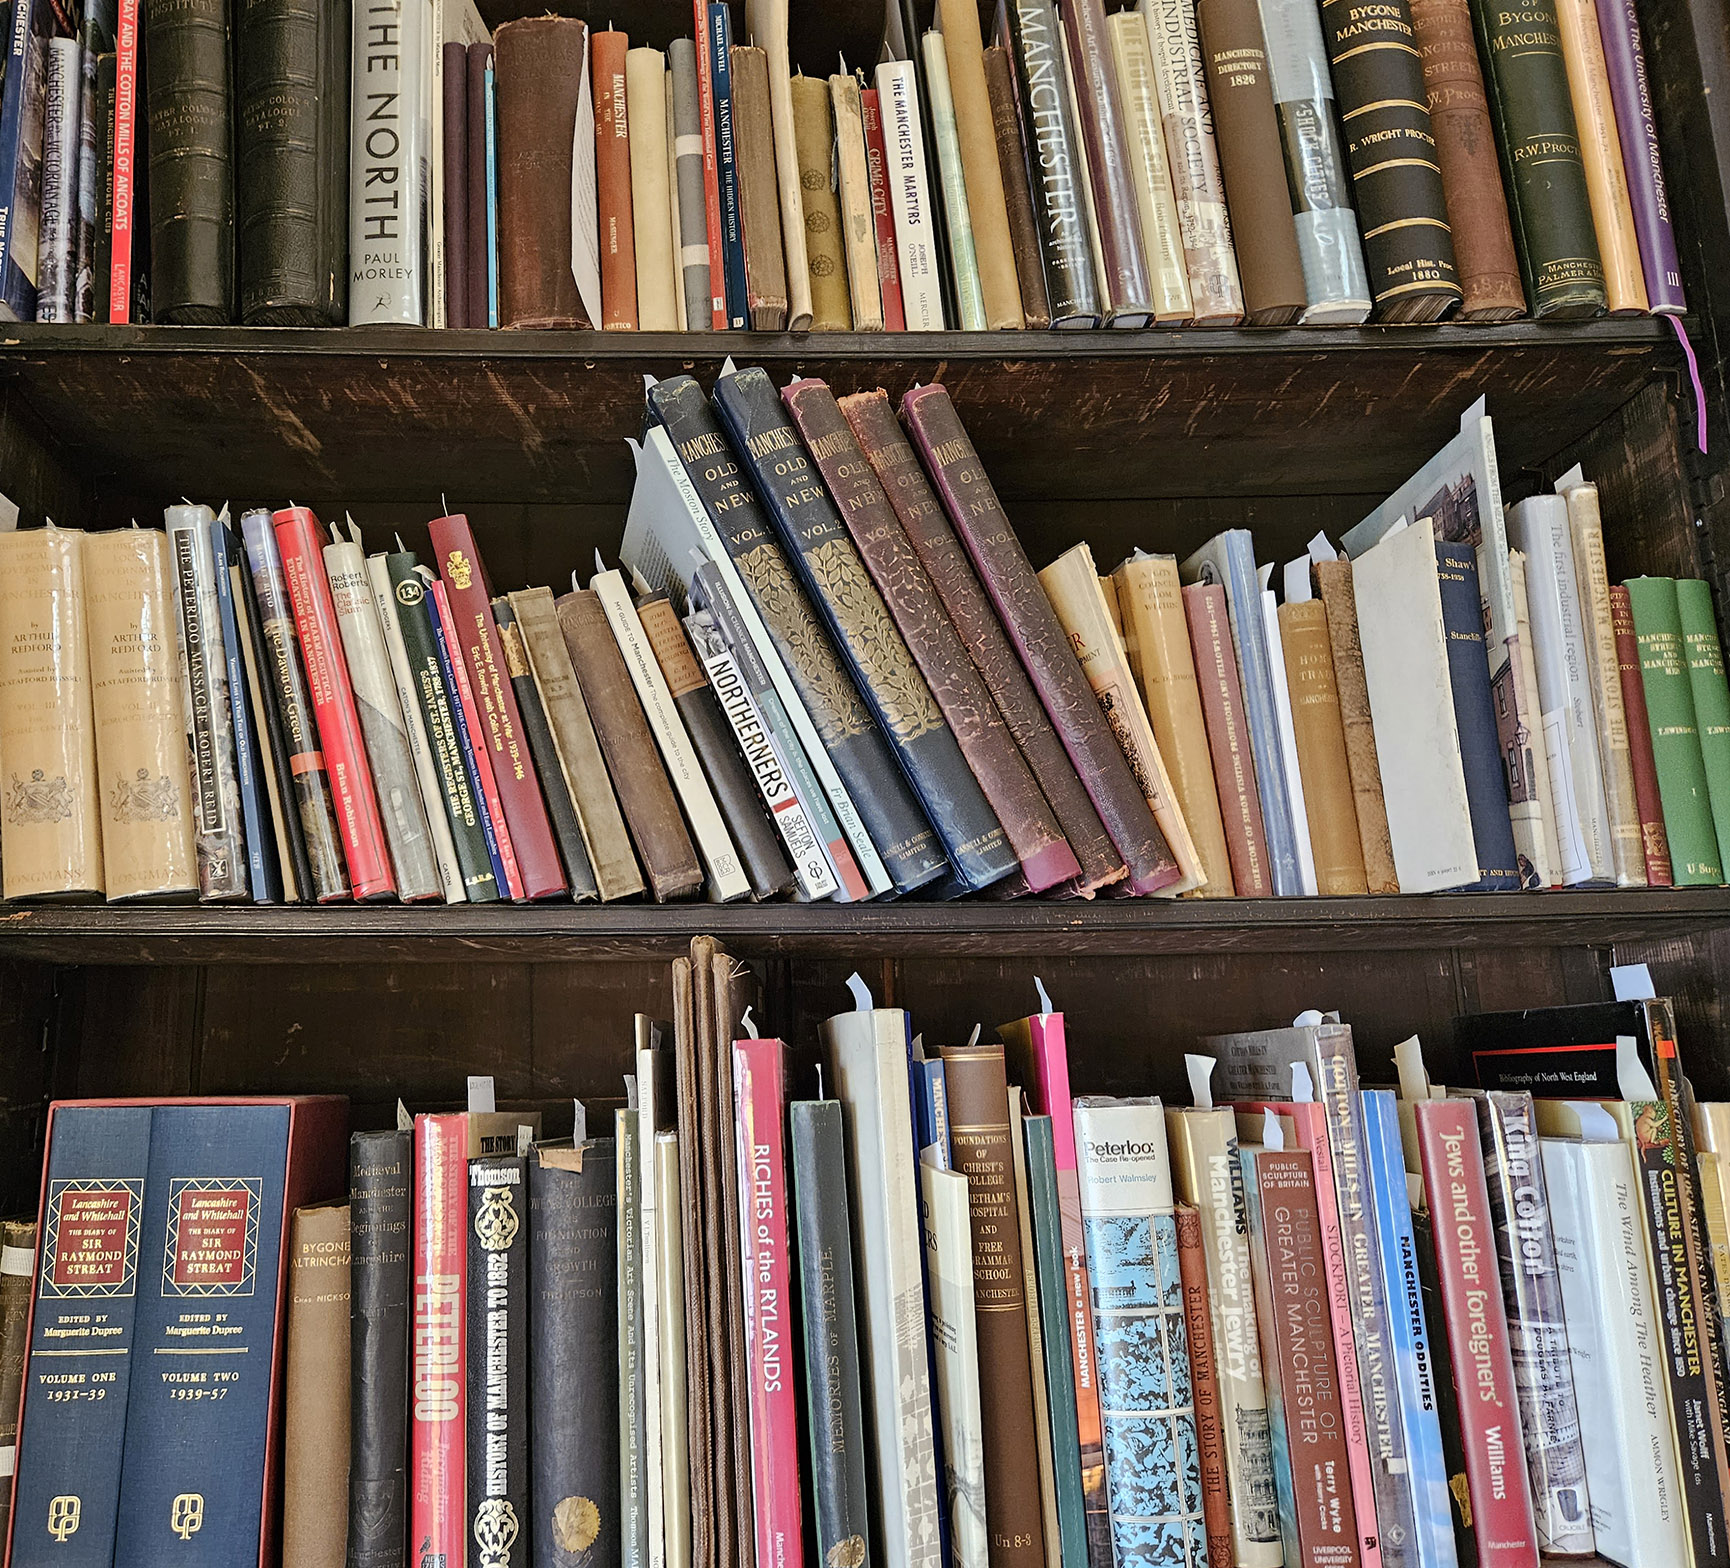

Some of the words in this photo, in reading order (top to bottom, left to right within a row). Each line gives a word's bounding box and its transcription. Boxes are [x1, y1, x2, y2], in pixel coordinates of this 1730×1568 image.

[1349, 4, 1402, 21] BYGONE
[120, 22, 136, 48] AND
[366, 0, 400, 73] THE
[1336, 18, 1414, 42] MANCHESTER
[1628, 22, 1641, 52] the
[119, 50, 135, 74] THE
[1213, 48, 1264, 63] MANCHESTER
[1216, 61, 1262, 75] DIRECTORY
[892, 77, 903, 97] THE
[1230, 74, 1256, 88] 1826
[1634, 54, 1653, 121] University
[107, 88, 115, 104] THE
[118, 75, 134, 120] COTTON
[612, 73, 629, 139] MANCHESTER
[1161, 0, 1190, 110] INDUSTRIAL
[1180, 117, 1208, 194] SOCIETY
[719, 98, 732, 164] MANCHESTER
[1017, 6, 1078, 234] MANCHESTER
[1645, 122, 1658, 143] of
[106, 110, 114, 165] MANCHESTER
[117, 121, 131, 155] MILLS
[893, 98, 914, 170] MANCHESTER
[1349, 142, 1360, 154] R.
[1360, 128, 1402, 147] WRIGHT
[116, 156, 130, 172] OF
[364, 92, 400, 240] NORTH
[105, 171, 113, 206] REFORM
[1648, 141, 1670, 224] Manchester
[114, 174, 129, 230] ANCOATS
[726, 187, 735, 213] HIDDEN
[903, 174, 921, 226] MARTYRS
[104, 210, 112, 234] CLUB
[728, 214, 737, 243] HISTORY
[364, 253, 400, 265] PAUL
[918, 243, 929, 275] JOSEPH
[1386, 260, 1414, 276] Local
[1415, 258, 1437, 270] Hist.
[353, 267, 413, 283] MORLEY
[1412, 270, 1441, 282] 1880
[919, 291, 930, 328] MERCIER
[704, 461, 740, 483] OLD
[774, 455, 808, 478] OLD
[790, 474, 810, 486] AND
[719, 479, 739, 491] AND
[784, 485, 826, 510] NEW
[667, 456, 680, 475] The
[674, 474, 698, 515] Moston
[694, 513, 714, 543] Story
[713, 492, 756, 516] NEW
[1551, 524, 1562, 544] The
[180, 533, 192, 566] THE
[1552, 549, 1565, 577] first
[330, 571, 363, 583] Robert
[1444, 556, 1475, 572] Shaw's
[332, 578, 369, 591] Roberts
[1588, 529, 1611, 629] MANCHESTER
[399, 586, 420, 601] 134
[183, 570, 202, 646] PETERLOO
[339, 606, 361, 617] Slum
[1556, 577, 1572, 646] industrial
[713, 581, 732, 610] ILLUSION
[730, 615, 748, 642] CHANGE
[743, 641, 767, 687] MANCHESTER
[1602, 634, 1614, 655] OF
[111, 643, 162, 655] REDFORD
[1564, 645, 1580, 683] region
[190, 651, 209, 725] MASSACRE
[618, 610, 631, 631] GUIDE
[631, 642, 655, 690] Manchester
[652, 702, 672, 734] complete
[665, 731, 678, 753] guide
[1604, 664, 1623, 713] STONES
[710, 659, 789, 799] NORTHERNERS
[1222, 700, 1239, 752] PROFESSORS
[1612, 719, 1626, 746] THE
[198, 730, 216, 780] ROBERT
[335, 762, 351, 792] Brian
[204, 783, 218, 826] REID
[830, 786, 843, 799] Fr
[342, 793, 359, 848] Robinson
[836, 799, 859, 830] Brian
[1238, 795, 1252, 823] SIMON
[779, 816, 807, 860] SAMUELS
[791, 814, 817, 851] SEFTON
[852, 829, 872, 861] Seale
[1246, 840, 1264, 890] DIRECTORY
[1084, 1139, 1156, 1158] Peterloo:
[468, 1165, 521, 1188] Thomson
[623, 1133, 634, 1201] Manchester's
[1262, 1170, 1309, 1181] SCULPTURE
[1268, 1162, 1299, 1172] PUBLIC
[753, 1143, 773, 1220] RICHES
[1614, 1183, 1628, 1204] The
[63, 1211, 80, 1222] and
[80, 1210, 126, 1222] Whitehall
[72, 1198, 120, 1210] Lancashire
[182, 1210, 200, 1222] and
[200, 1209, 245, 1221] Whitehall
[192, 1197, 239, 1210] Lancashire
[625, 1207, 636, 1263] Victorian
[757, 1222, 772, 1246] of
[1618, 1209, 1634, 1242] Wind
[61, 1250, 123, 1262] RAYMOND
[82, 1239, 103, 1250] SIR
[180, 1249, 242, 1262] RAYMOND
[201, 1237, 223, 1249] SIR
[302, 1241, 351, 1255] BYGONE
[66, 1263, 114, 1276] STREAT
[186, 1262, 234, 1275] STREAT
[486, 1252, 508, 1286] 1852
[626, 1265, 636, 1281] Art
[758, 1247, 774, 1283] the
[1206, 1155, 1234, 1300] Manchester
[1222, 1303, 1248, 1383] Jewry
[486, 1287, 508, 1308] TO
[1624, 1255, 1643, 1317] Among
[626, 1283, 637, 1321] Scene
[58, 1314, 91, 1324] EDITED
[95, 1314, 109, 1324] BY
[164, 1325, 213, 1338] Marguerite
[211, 1325, 244, 1336] Dupree
[178, 1313, 212, 1324] EDITED
[1274, 1205, 1300, 1297] GREATER
[1287, 1302, 1319, 1445] MANCHESTER
[1400, 1235, 1423, 1337] MANCHESTER
[1414, 1340, 1433, 1412] ODDITIES
[1635, 1320, 1649, 1342] The
[43, 1327, 91, 1339] Marguerite
[91, 1326, 124, 1337] Dupree
[759, 1287, 783, 1392] RYLANDS
[414, 1273, 461, 1423] PETERLOO
[486, 1310, 508, 1406] MANCHESTER
[39, 1374, 87, 1385] VOLUME
[91, 1372, 118, 1383] ONE
[160, 1372, 208, 1384] VOLUME
[212, 1371, 241, 1383] TWO
[1639, 1345, 1658, 1418] Heather
[46, 1388, 107, 1402] 1931-39
[169, 1387, 229, 1401] 1939-57
[486, 1408, 508, 1430] OF
[628, 1370, 639, 1450] Unrecognised
[486, 1432, 508, 1498] HISTORY
[1484, 1424, 1507, 1501] Williams
[629, 1455, 640, 1499] Artists
[630, 1505, 641, 1548] Thomson
